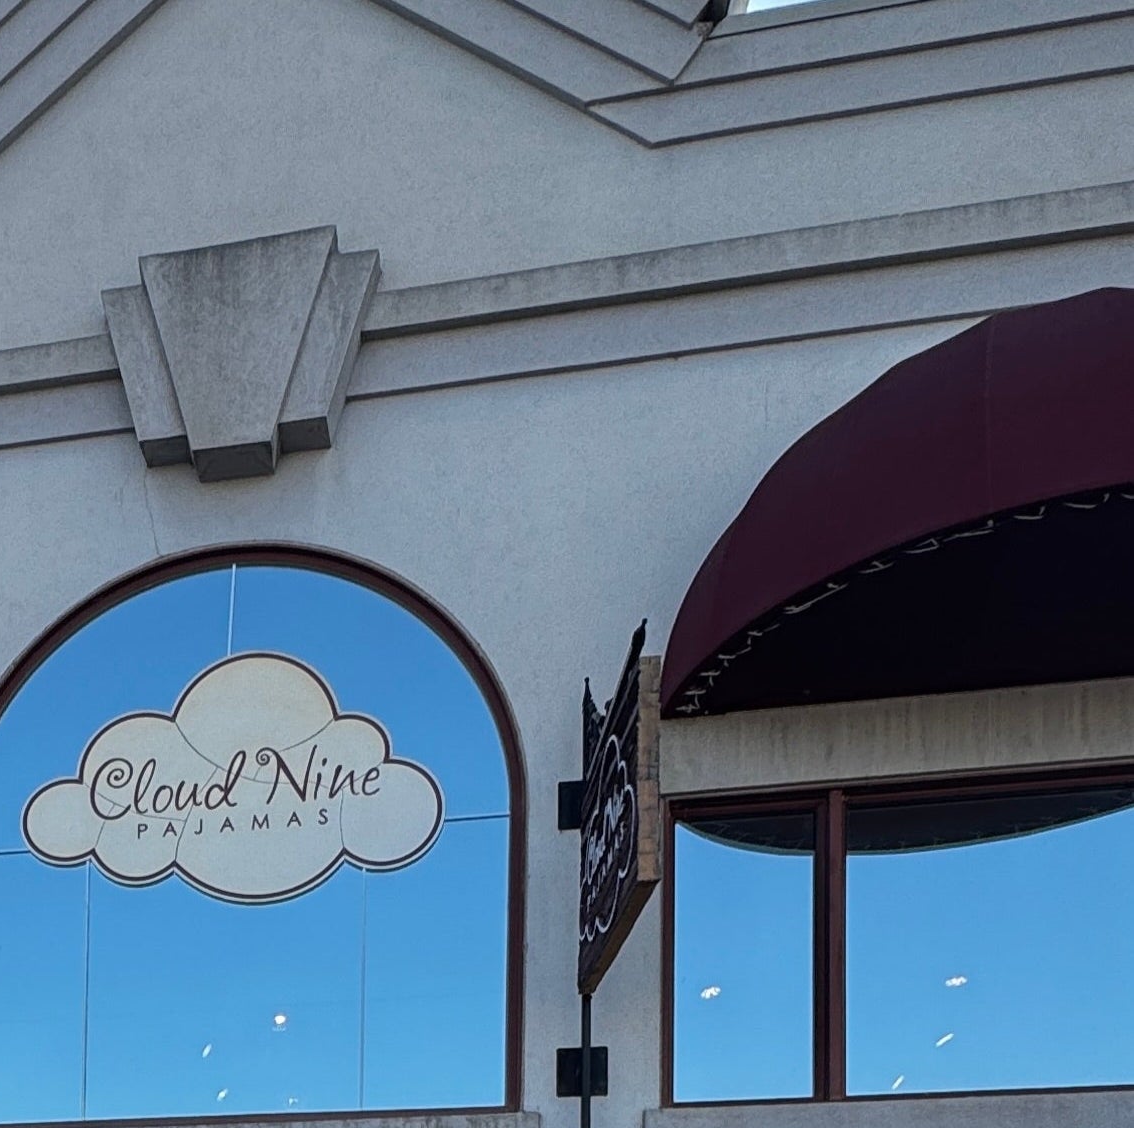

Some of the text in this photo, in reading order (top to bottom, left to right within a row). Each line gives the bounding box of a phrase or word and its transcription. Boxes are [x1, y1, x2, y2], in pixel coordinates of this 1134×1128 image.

[90, 744, 380, 820] Cloud Nine
[137, 808, 330, 839] PAJAMAS
